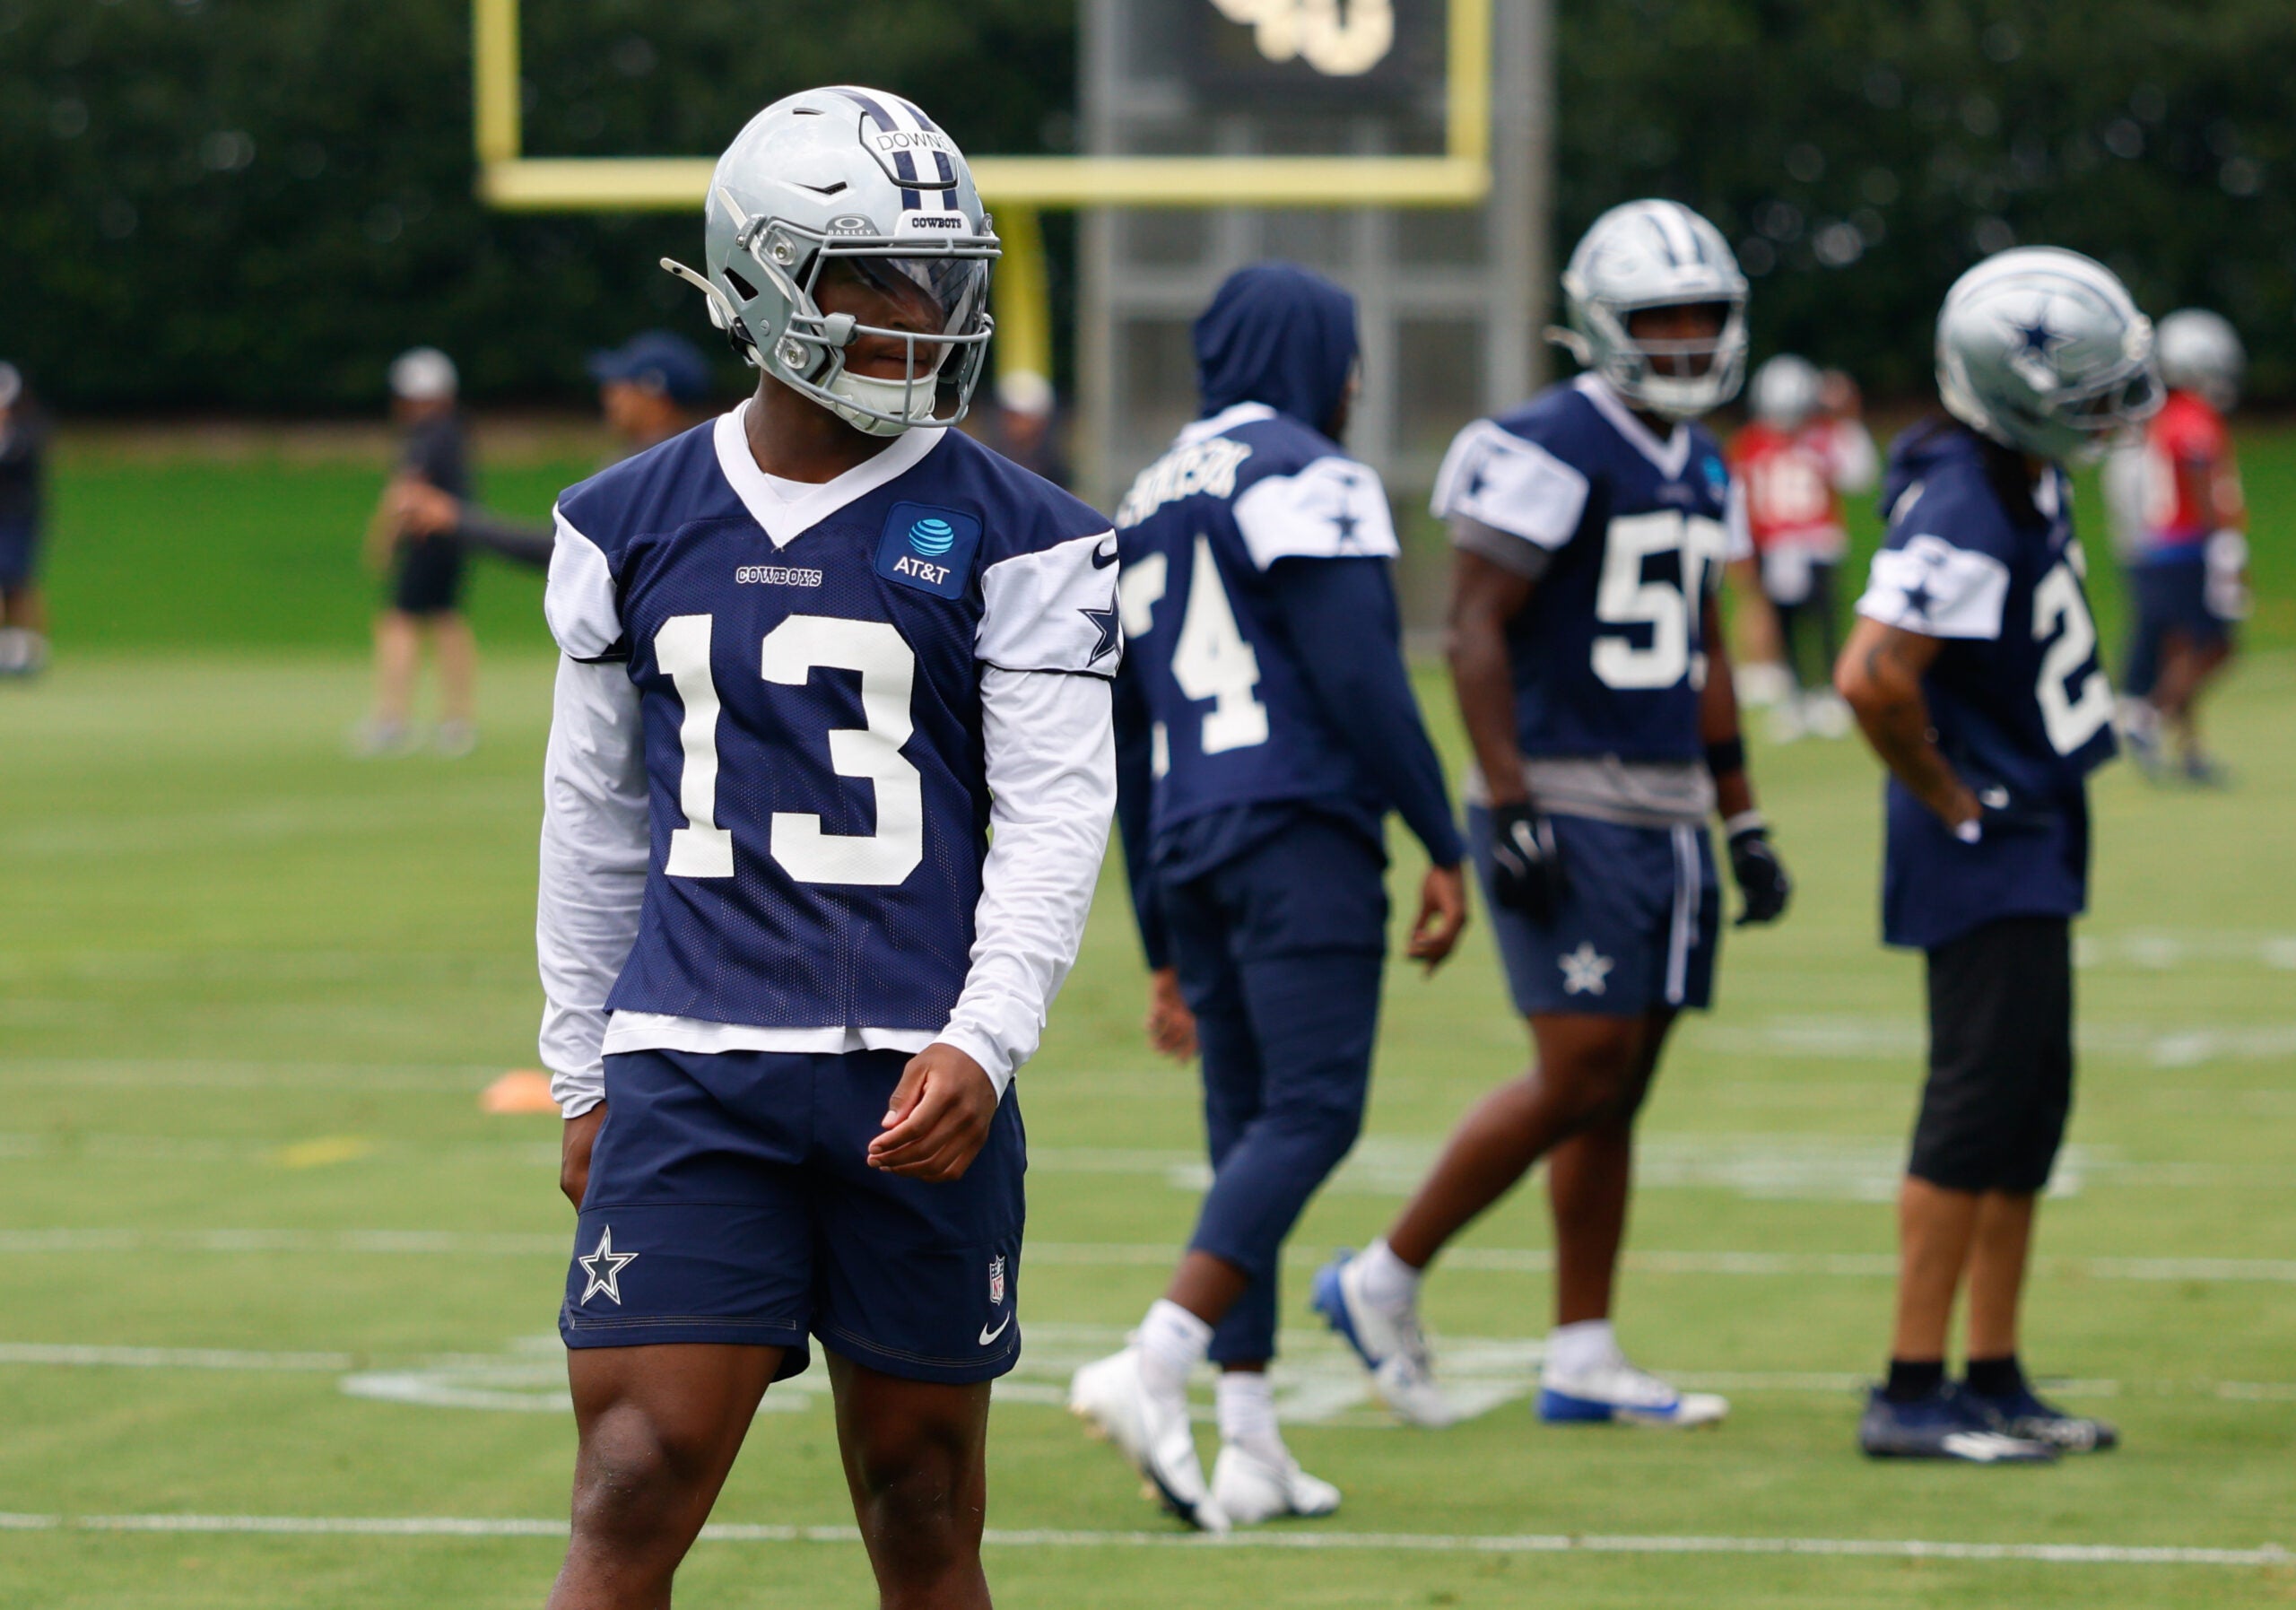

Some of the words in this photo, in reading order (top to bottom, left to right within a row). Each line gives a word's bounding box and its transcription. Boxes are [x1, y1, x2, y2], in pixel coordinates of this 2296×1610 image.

[876, 133, 951, 152] DOWNS
[912, 218, 961, 229] COWBOYS
[736, 566, 822, 587] COWBOYS
[893, 556, 950, 585] AT&T
[2031, 539, 2119, 756] 2
[654, 614, 924, 885] 13
[992, 1275, 1004, 1298] NF
